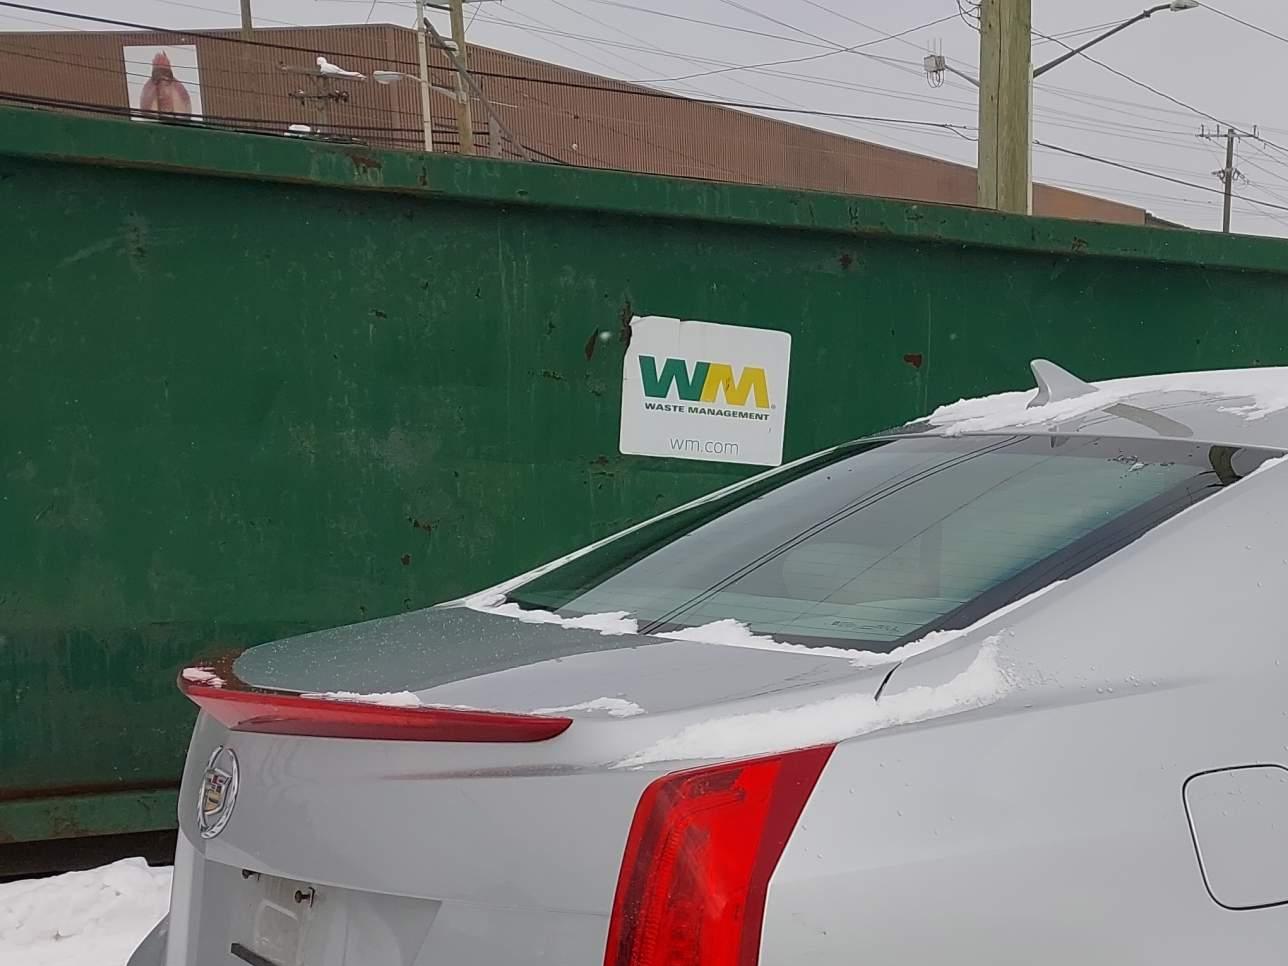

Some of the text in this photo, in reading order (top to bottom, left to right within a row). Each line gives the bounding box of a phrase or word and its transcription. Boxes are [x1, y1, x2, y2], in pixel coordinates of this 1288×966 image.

[638, 355, 770, 409] WM
[645, 402, 770, 421] WASTE MANAGEMENT
[670, 438, 739, 455] wm.com
